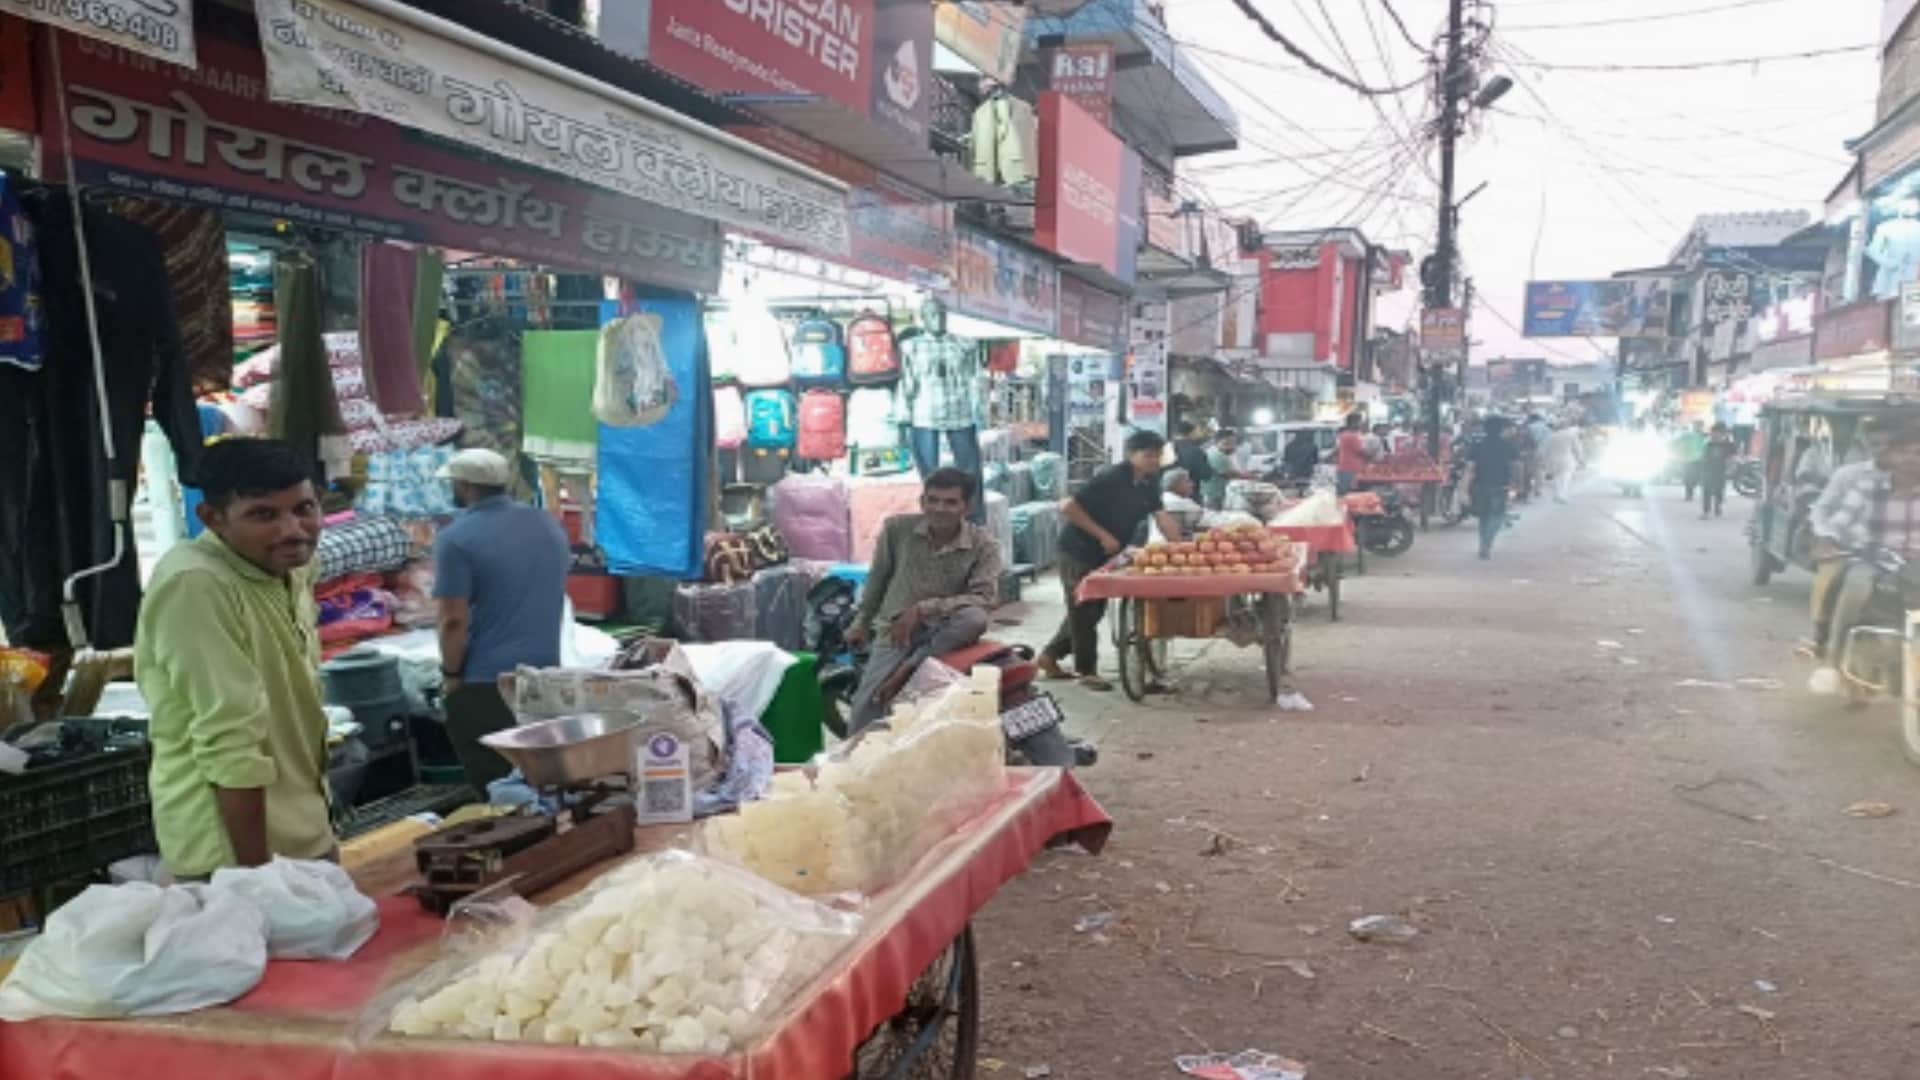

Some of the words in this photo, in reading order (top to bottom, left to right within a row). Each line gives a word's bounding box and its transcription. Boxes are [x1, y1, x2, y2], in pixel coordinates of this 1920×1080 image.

[67, 83, 375, 199] गोयल
[391, 165, 568, 239] क्लॉथ
[443, 75, 627, 174] गोयल
